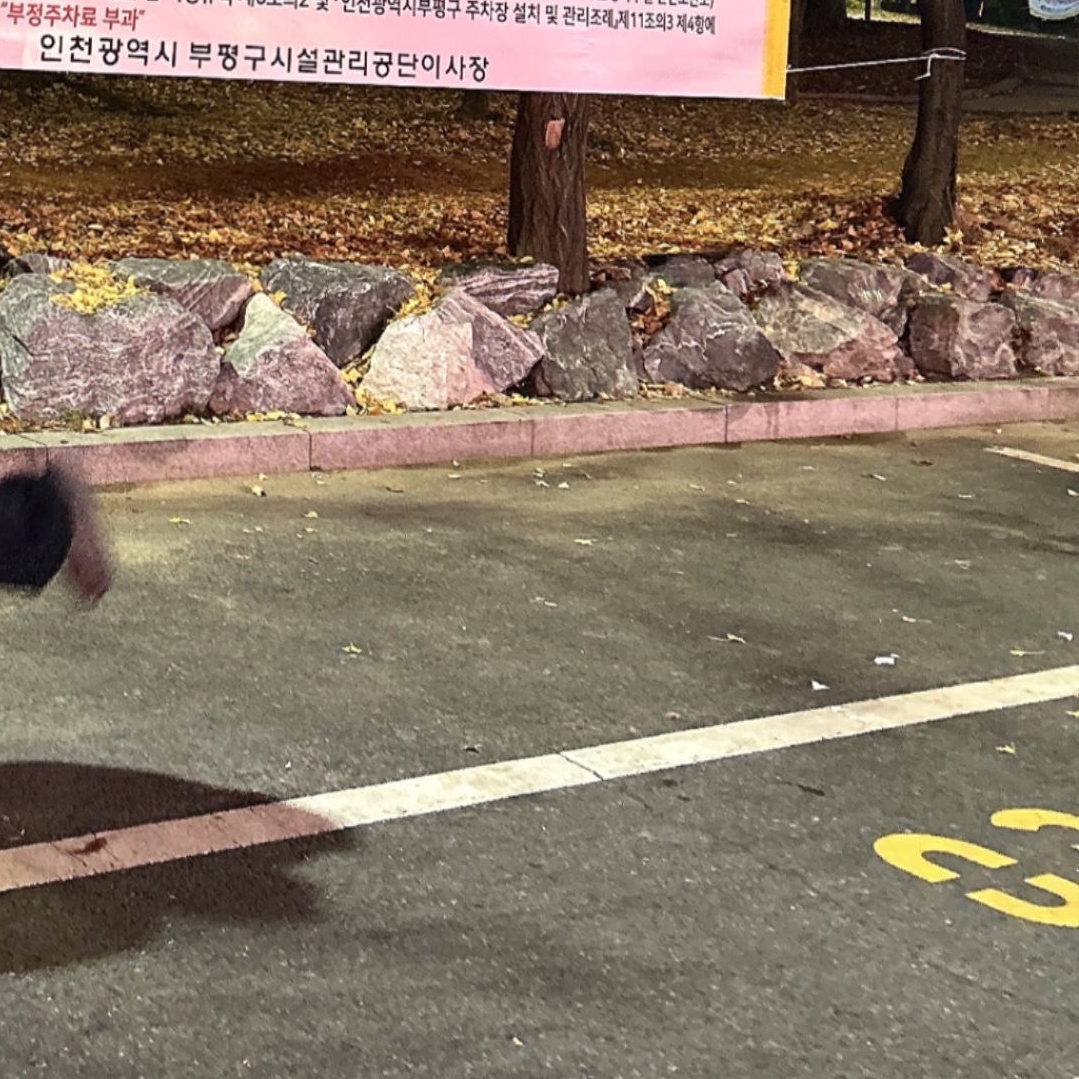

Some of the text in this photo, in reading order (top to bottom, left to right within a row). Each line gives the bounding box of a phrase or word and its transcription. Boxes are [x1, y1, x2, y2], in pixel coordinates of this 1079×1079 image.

[465, 0, 509, 22] 주차장
[513, 2, 540, 24] 설치
[545, 4, 558, 26] 및
[676, 13, 716, 35] 제4항에
[39, 33, 490, 82] 인천광역시 부평구시설관리공단이사장
